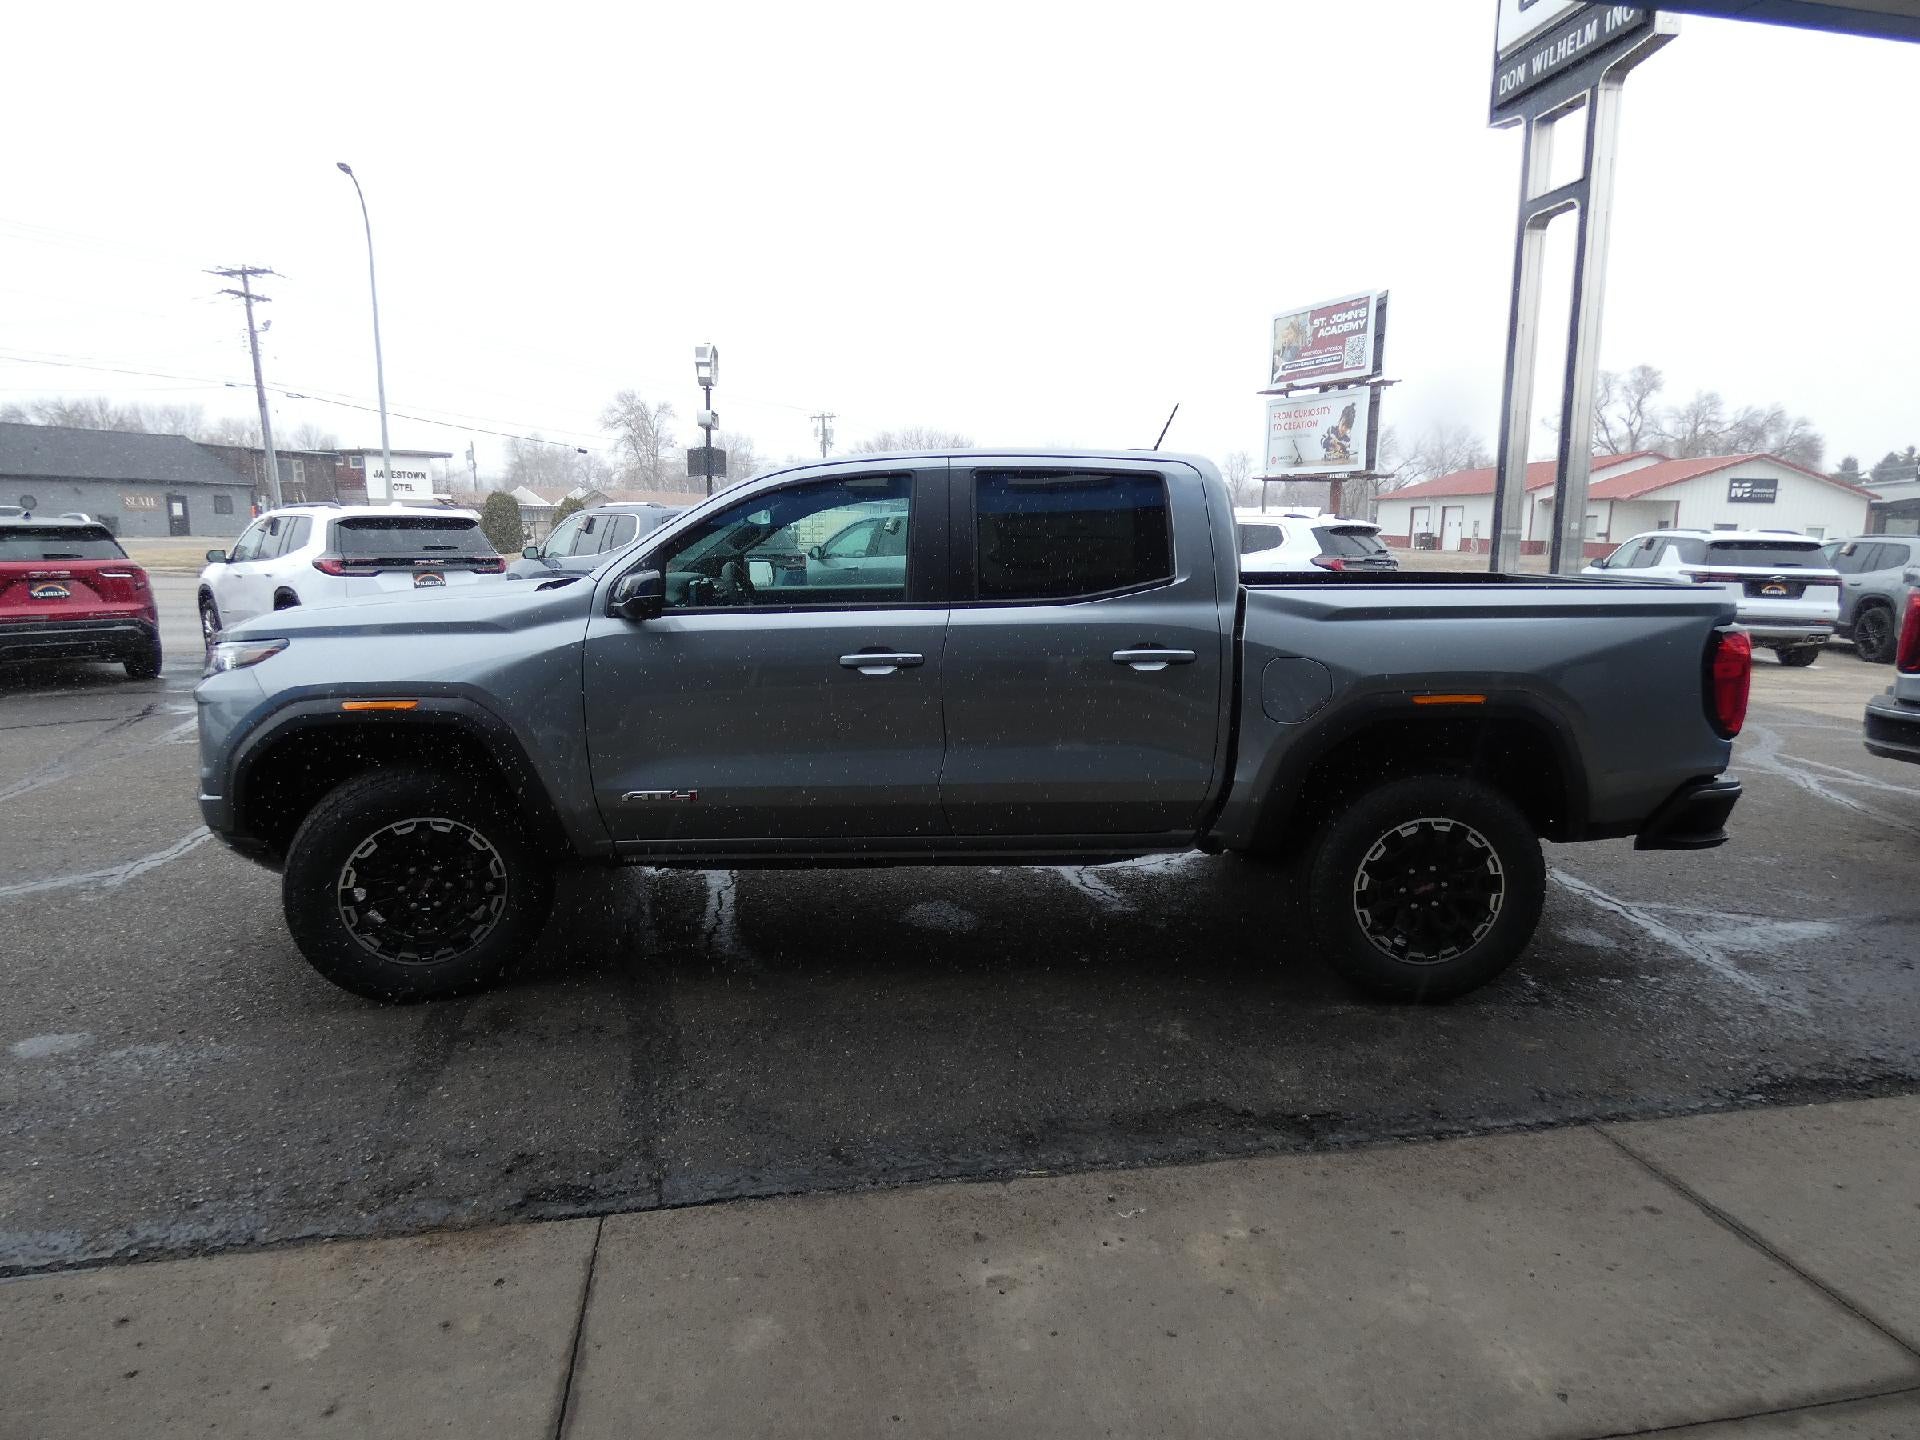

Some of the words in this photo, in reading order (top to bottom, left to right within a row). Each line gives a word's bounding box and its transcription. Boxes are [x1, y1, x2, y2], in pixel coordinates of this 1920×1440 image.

[1499, 63, 1527, 95] DON
[1532, 19, 1598, 76] WILHELM
[1313, 317, 1327, 328] ST.
[1330, 307, 1367, 324] JOHN'S
[1318, 319, 1367, 338] ACADEMY
[1273, 411, 1292, 420] FROM
[1293, 406, 1331, 419] CURIOSITY
[1273, 423, 1282, 431] TO
[1283, 420, 1318, 431] CREATION
[373, 469, 427, 480] JAESTOWN
[390, 483, 415, 492] OTEL
